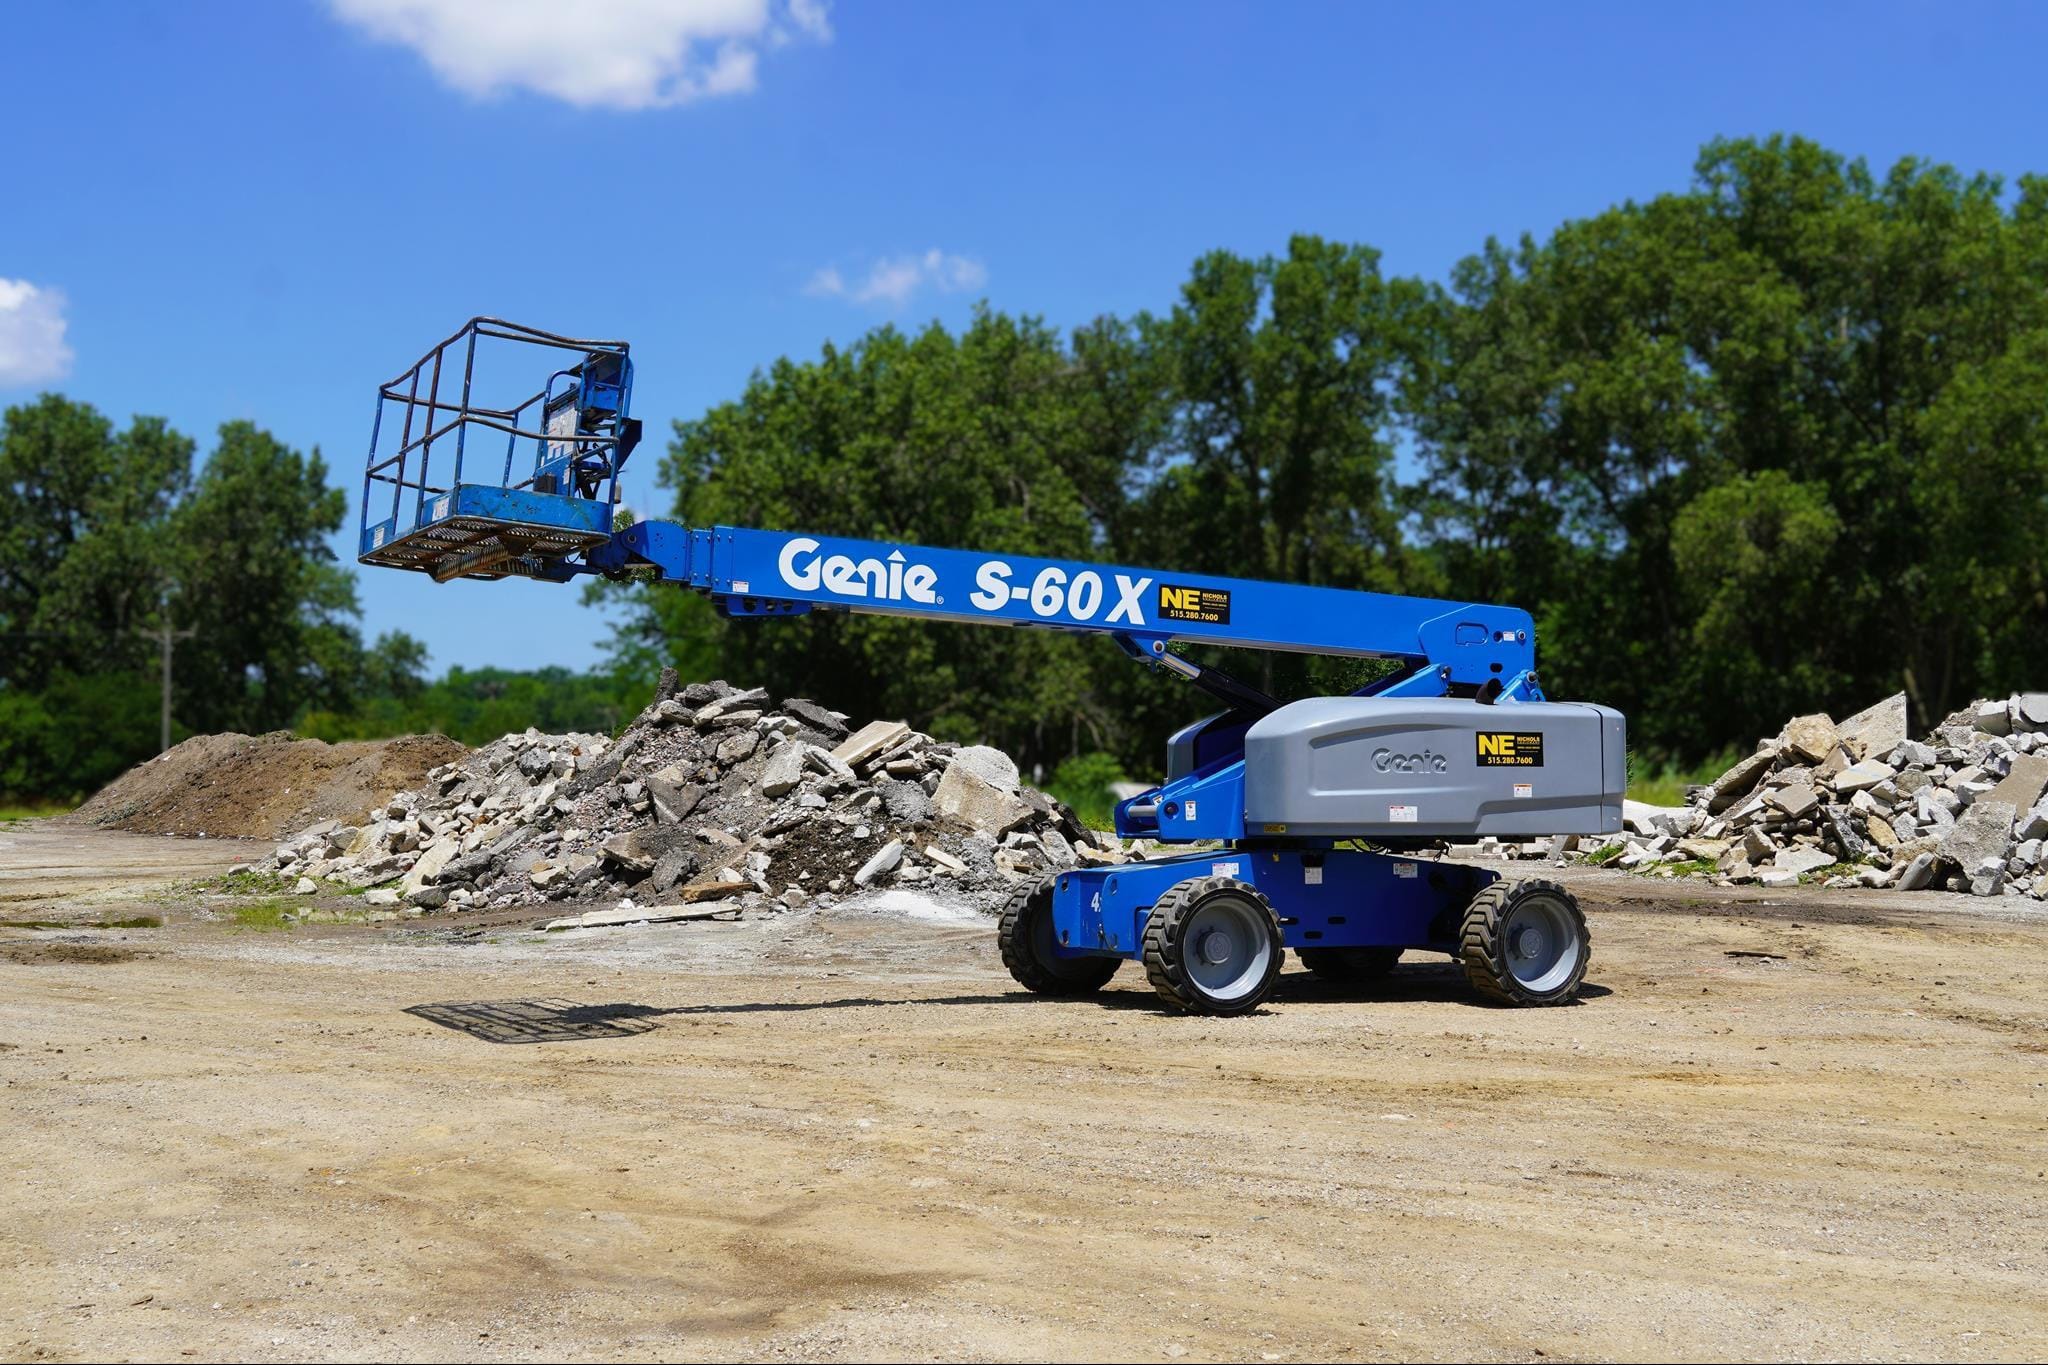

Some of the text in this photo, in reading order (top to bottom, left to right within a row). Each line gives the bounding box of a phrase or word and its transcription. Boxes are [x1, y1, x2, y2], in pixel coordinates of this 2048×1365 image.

[778, 537, 938, 604] Genie
[969, 560, 1153, 625] S-60 X
[1161, 587, 1200, 611] NE
[1202, 592, 1228, 600] NICHOLS
[1170, 610, 1219, 621] 515.280.7600
[1478, 734, 1516, 755] NE
[1370, 746, 1448, 774] Genie
[1487, 756, 1533, 764] 515.280.7600
